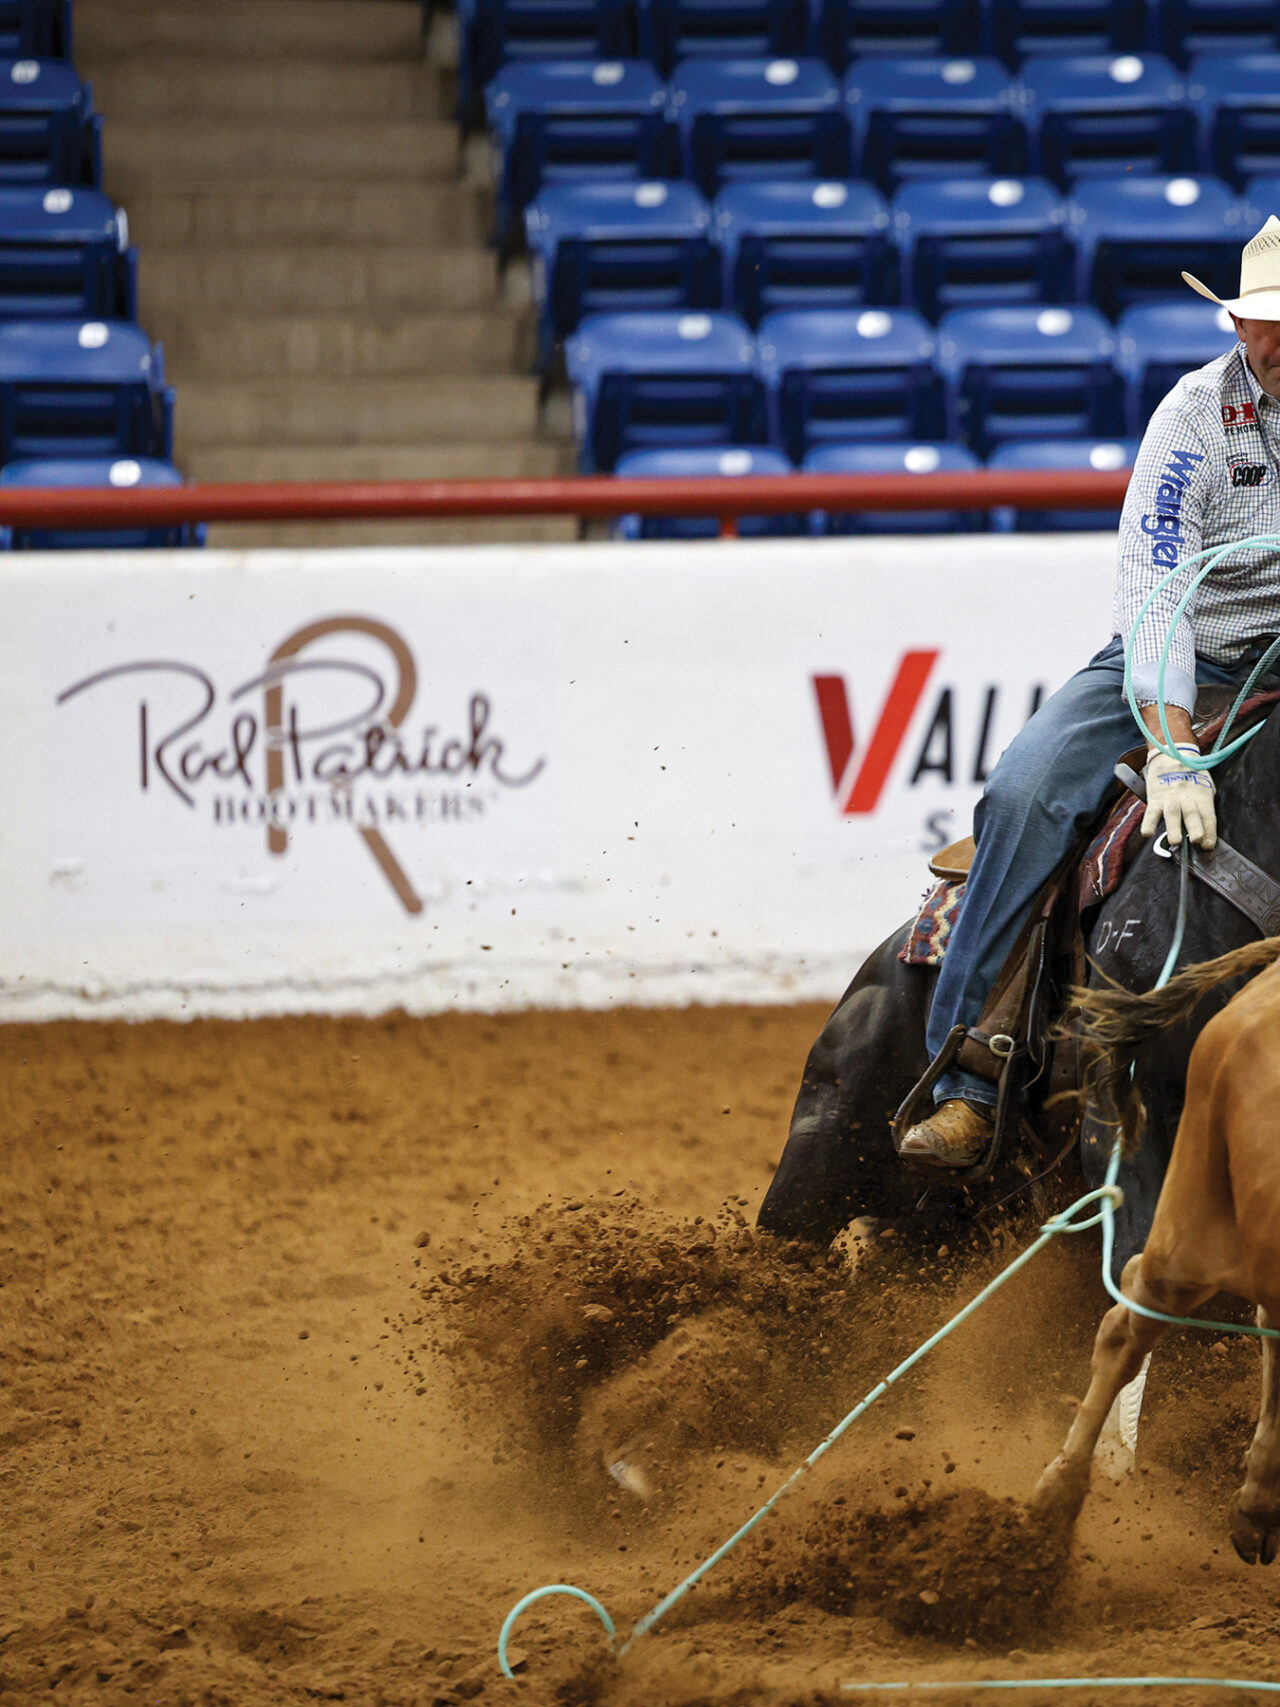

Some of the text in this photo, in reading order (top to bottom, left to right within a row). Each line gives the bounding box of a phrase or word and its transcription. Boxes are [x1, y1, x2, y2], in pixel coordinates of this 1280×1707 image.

[1141, 450, 1205, 571] Wrangler
[1232, 465, 1267, 488] COOP
[55, 658, 548, 811] Rod Patrick
[1158, 771, 1213, 788] Classic
